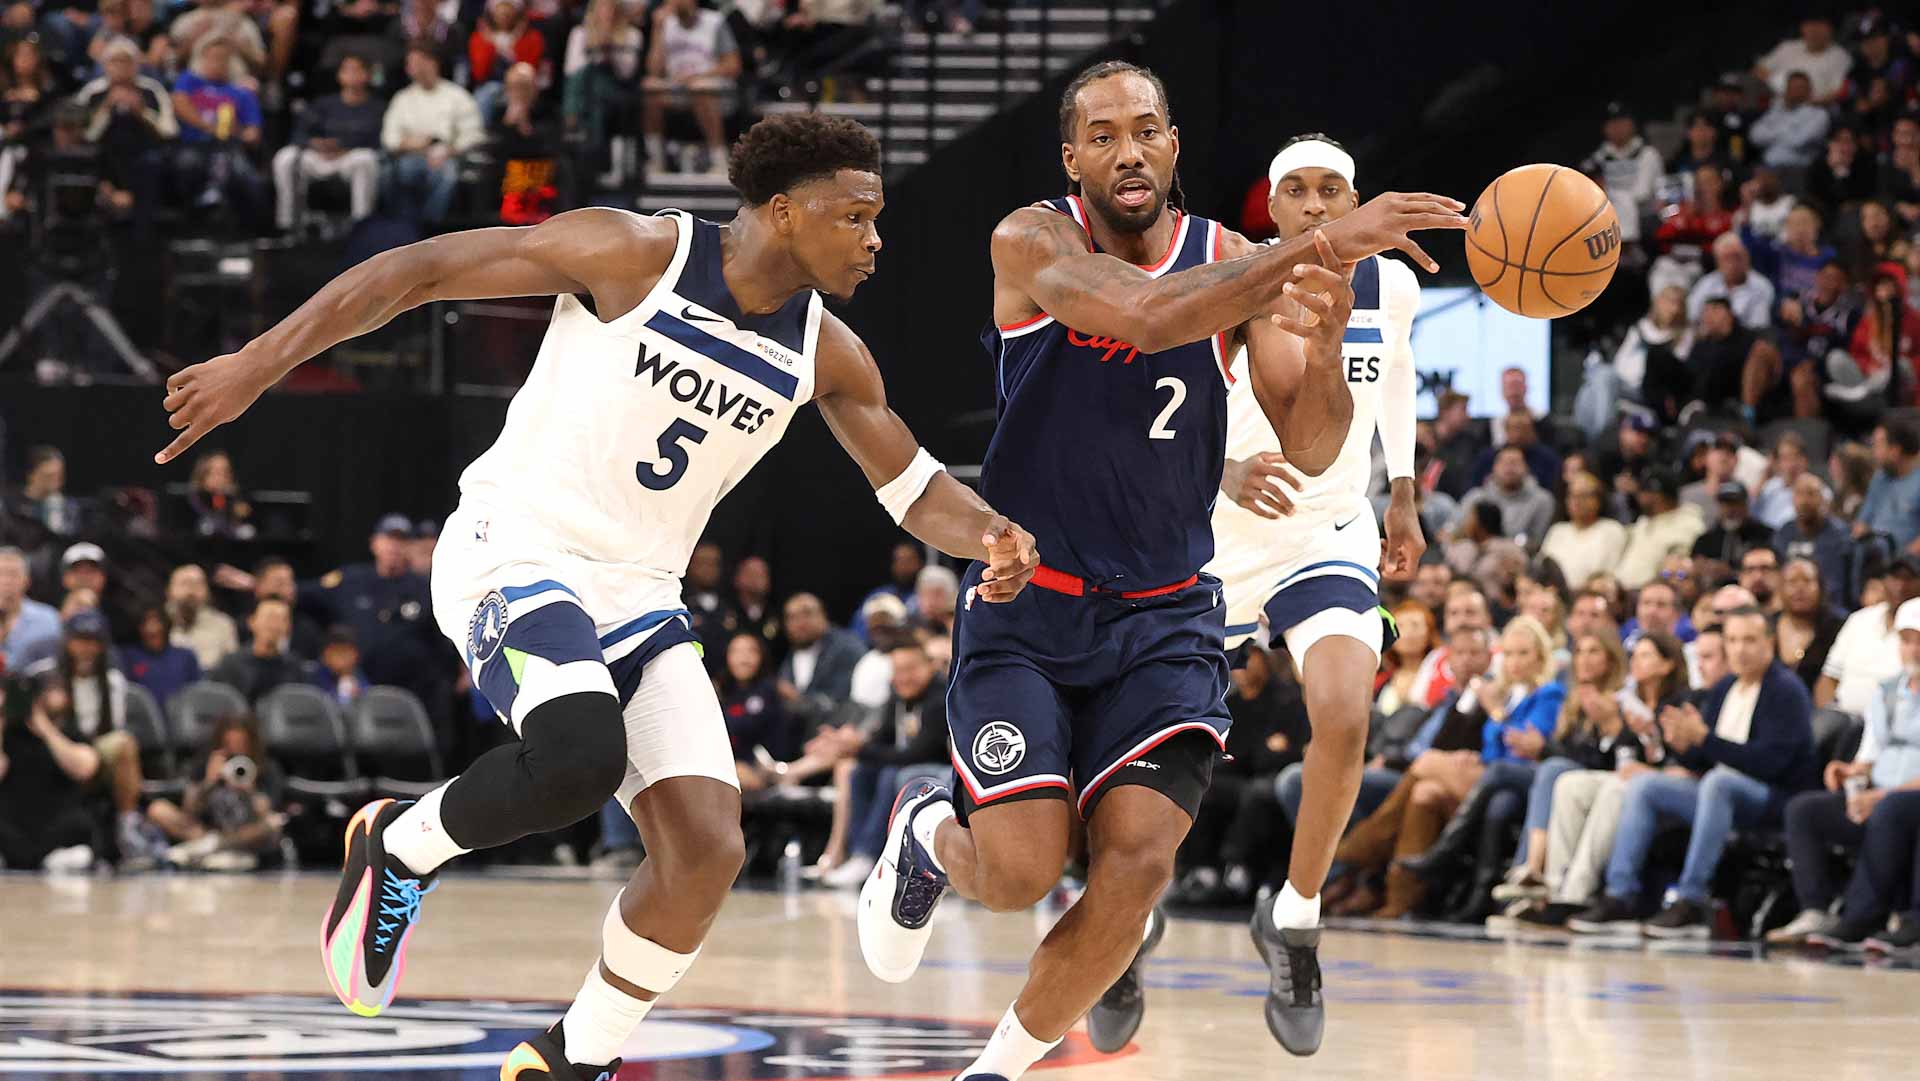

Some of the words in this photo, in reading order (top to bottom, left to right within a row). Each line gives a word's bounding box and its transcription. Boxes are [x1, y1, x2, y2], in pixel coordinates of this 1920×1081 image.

[764, 346, 793, 367] sezzle
[1342, 356, 1381, 383] ES
[635, 342, 775, 435] WOLVES
[1148, 377, 1187, 440] 2
[635, 417, 708, 491] 5
